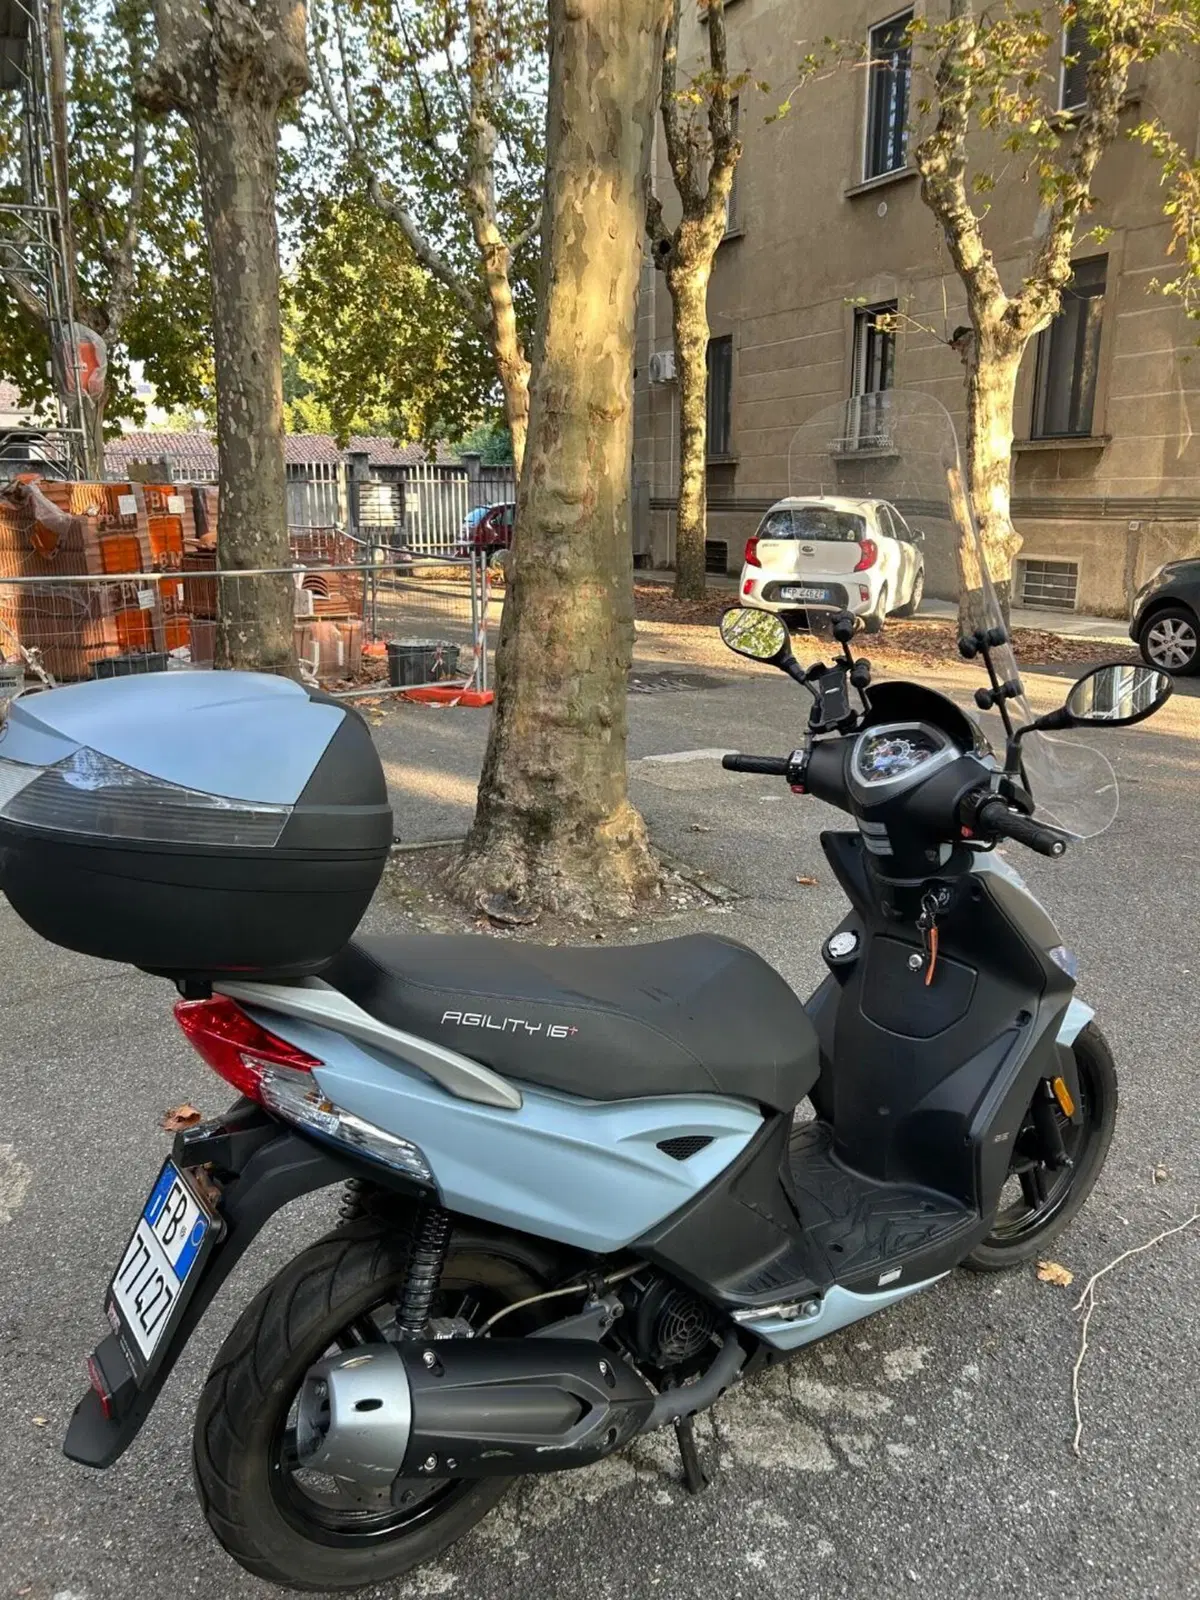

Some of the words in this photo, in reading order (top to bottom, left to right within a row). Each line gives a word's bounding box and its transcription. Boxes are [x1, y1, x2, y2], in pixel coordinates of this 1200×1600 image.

[440, 1011, 541, 1036] AGILITY
[155, 1182, 187, 1245] FB
[119, 1234, 173, 1337] 77427
